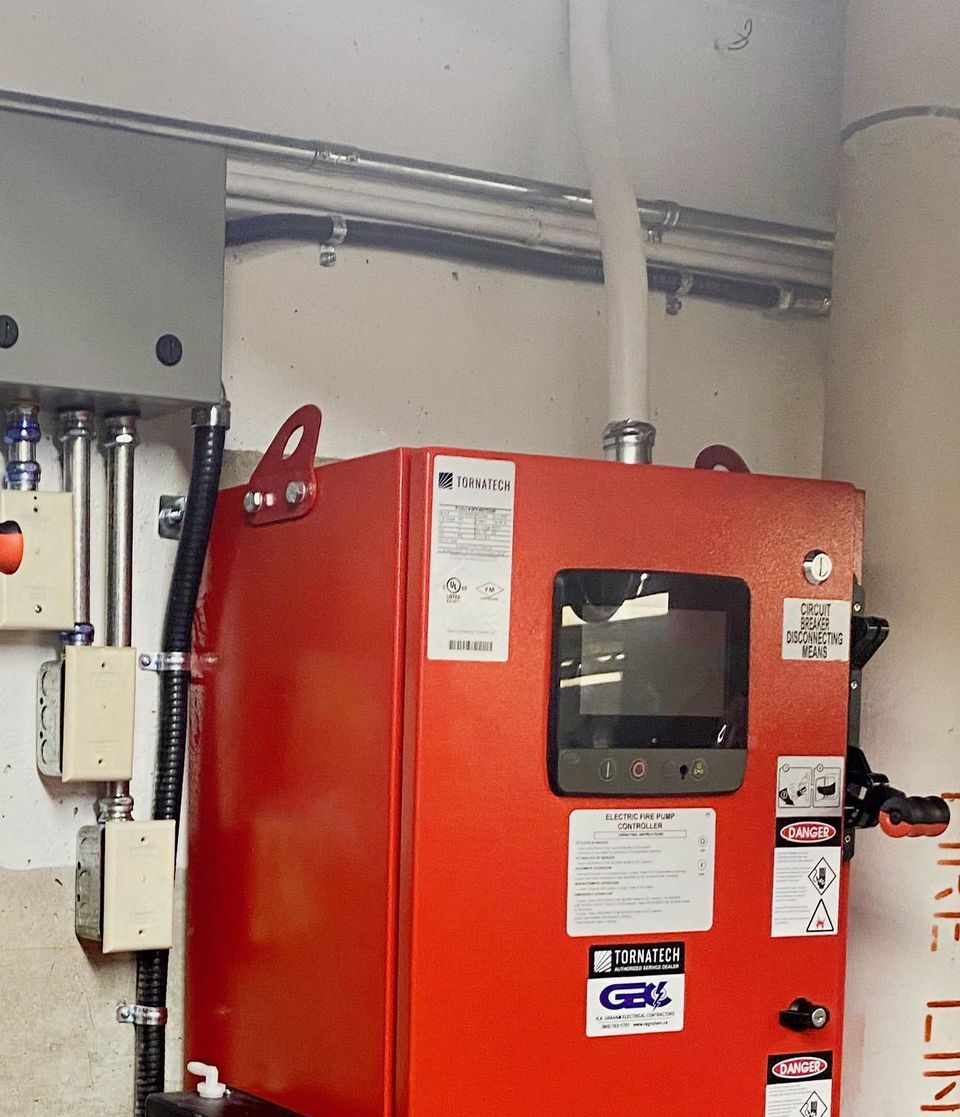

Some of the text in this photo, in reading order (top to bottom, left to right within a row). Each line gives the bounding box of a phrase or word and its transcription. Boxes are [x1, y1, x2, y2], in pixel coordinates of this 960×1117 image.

[457, 476, 511, 492] TORNATECH
[800, 602, 831, 616] CIRCUIT
[800, 617, 830, 630] BREAKER
[786, 631, 843, 645] DISCONNECTING
[802, 646, 827, 658] MEANS
[656, 812, 675, 820] PUMP
[618, 822, 663, 830] CONTROLLER
[788, 826, 830, 839] DANGER
[614, 947, 680, 964] TORNATECH
[780, 1061, 821, 1075] DANGER
